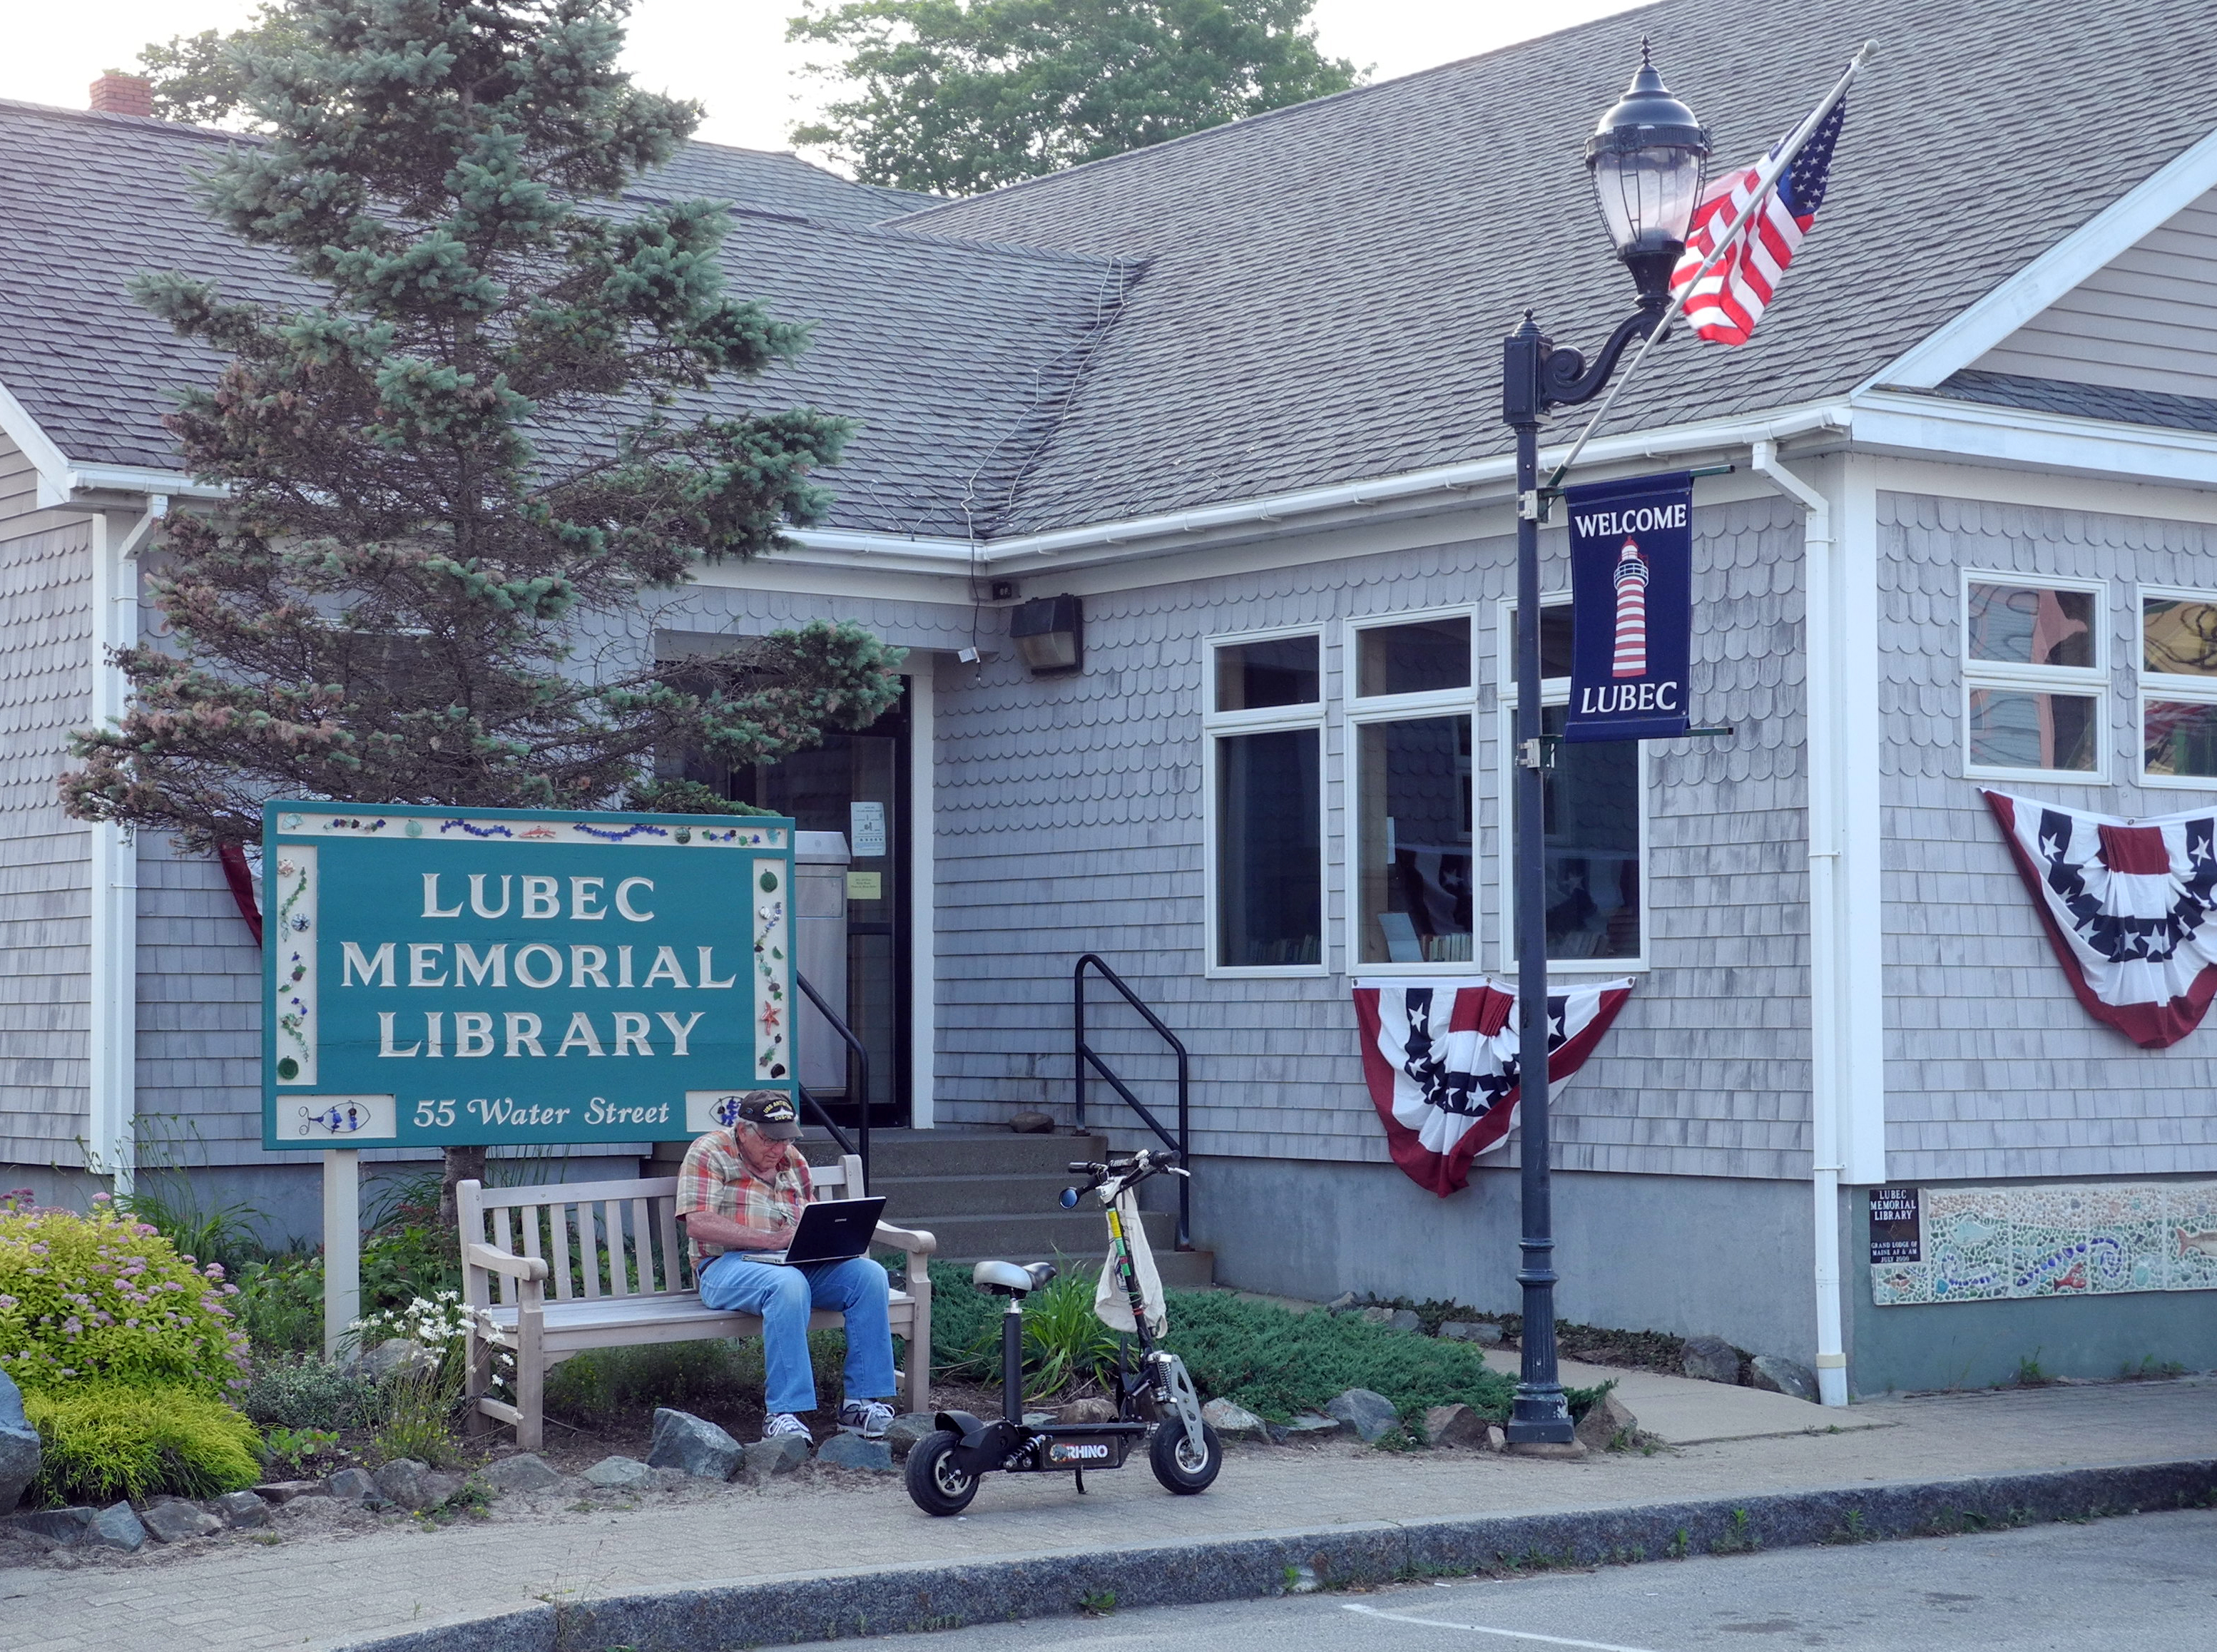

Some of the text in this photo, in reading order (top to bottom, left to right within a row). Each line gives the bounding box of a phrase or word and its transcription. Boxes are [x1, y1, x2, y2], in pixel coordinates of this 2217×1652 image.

[1574, 504, 1687, 538] WELCOME
[1581, 681, 1677, 713] LUBEC
[420, 873, 655, 922] LUBEC
[340, 942, 737, 989] MEMORIAL
[377, 1011, 705, 1057] LIBRARY
[413, 1097, 670, 1127] 55 Water Street
[1870, 1200, 1917, 1210] MEMORIAL
[1879, 1190, 1907, 1200] LUBEC
[1874, 1210, 1912, 1220] LIBRARY
[1065, 1444, 1108, 1459] RHINO
